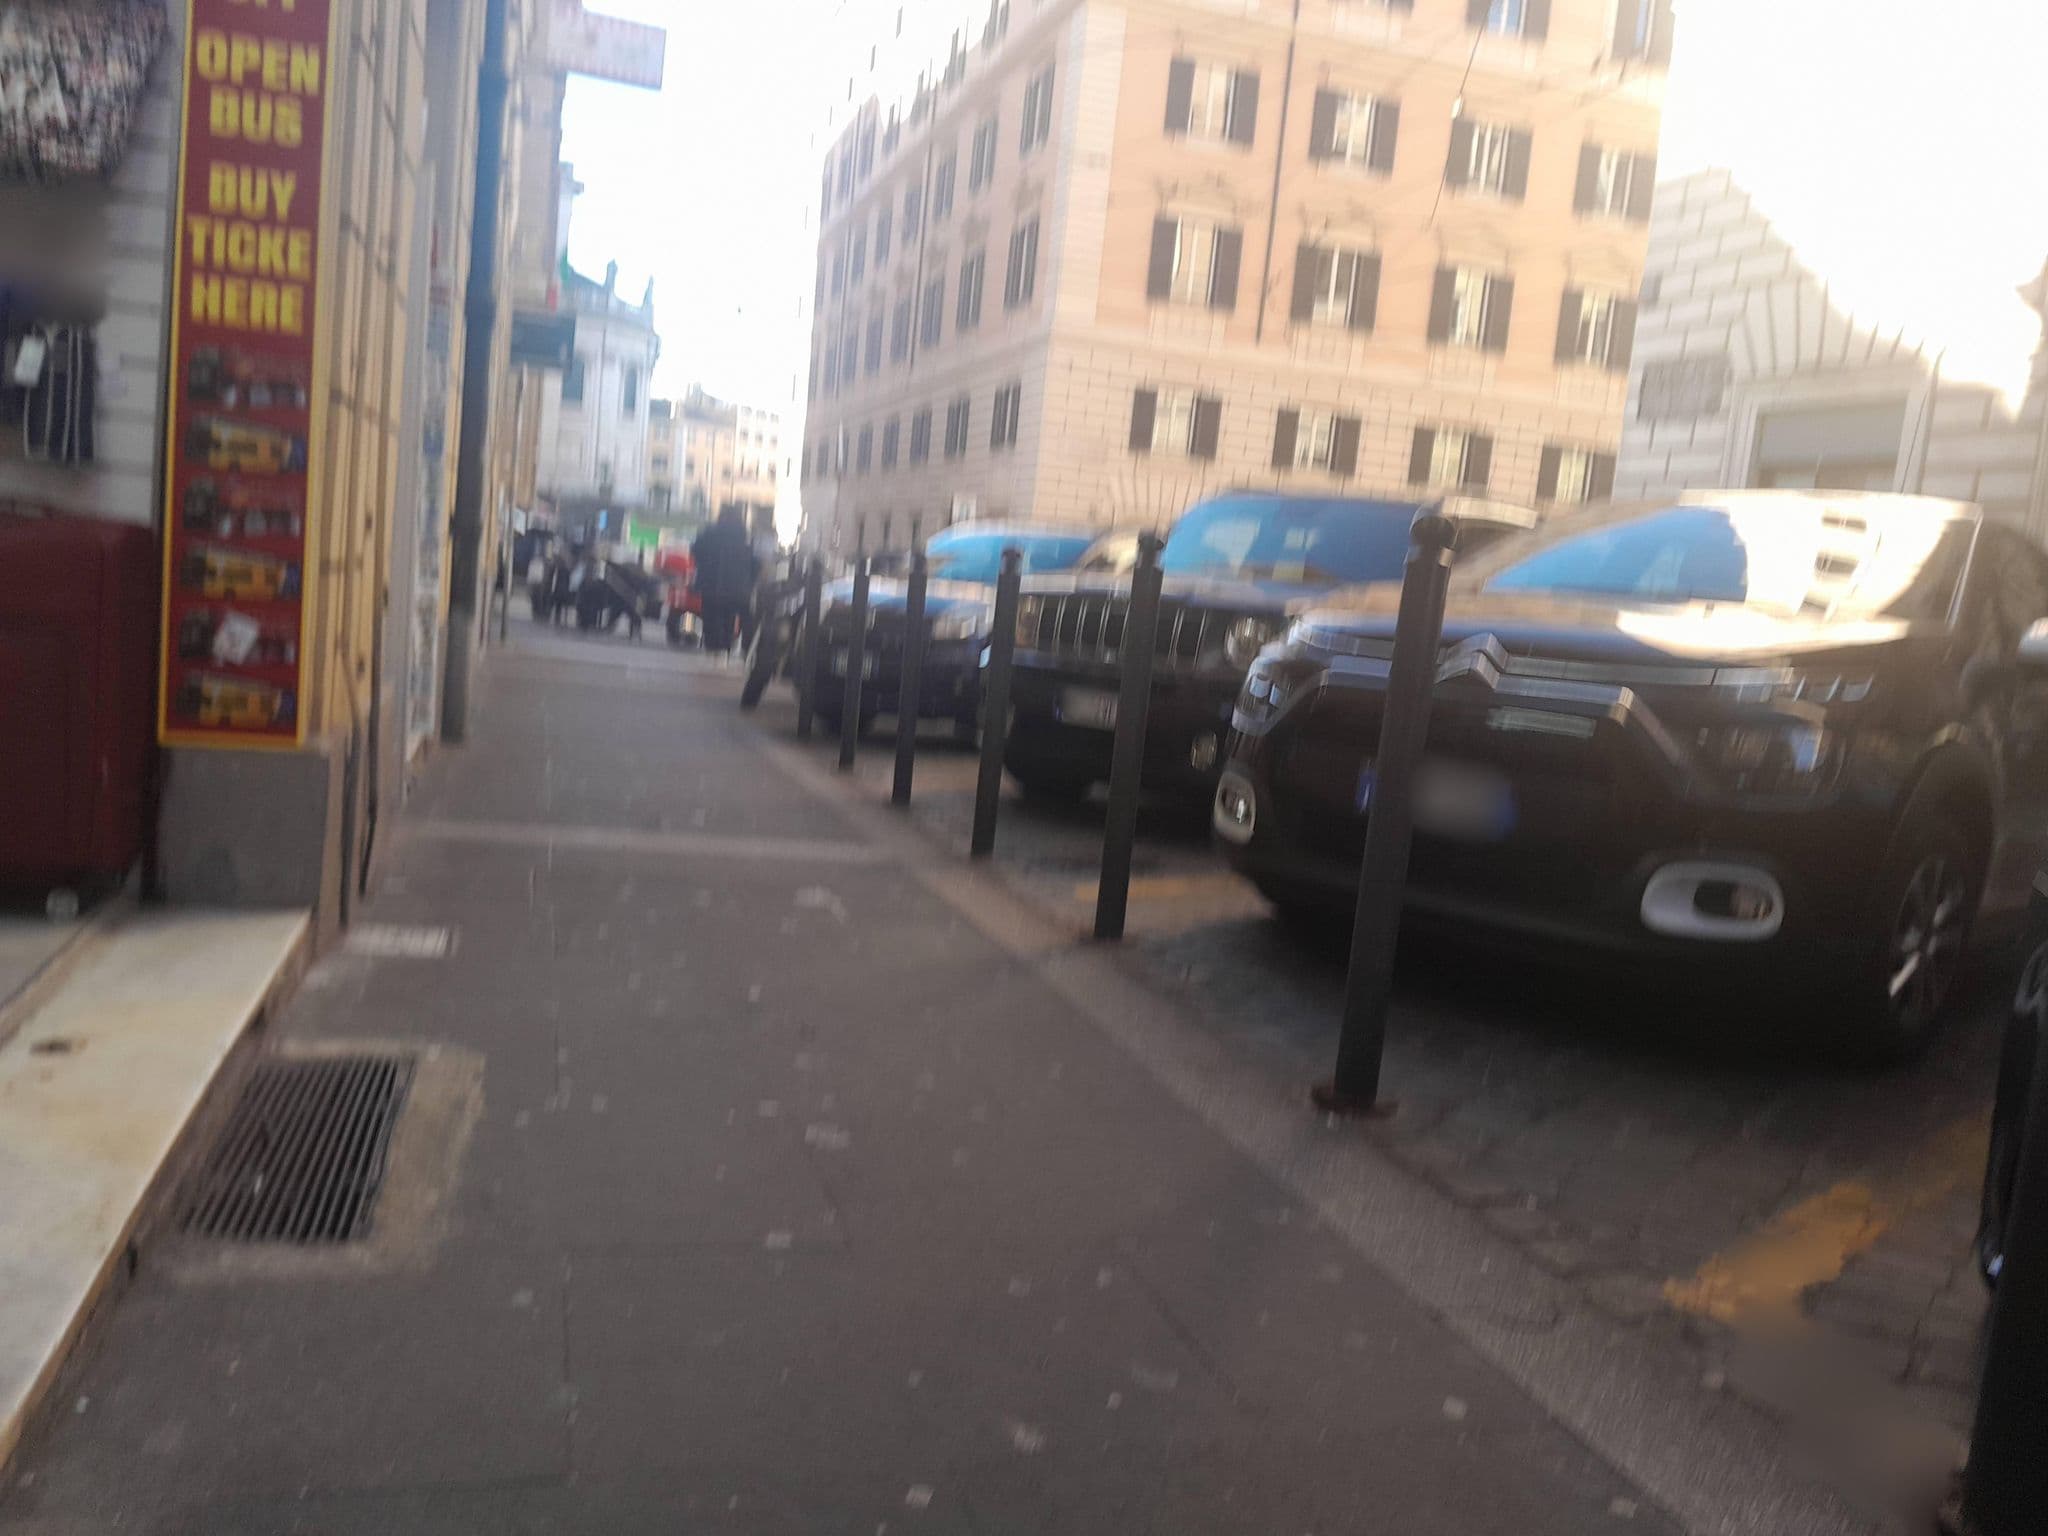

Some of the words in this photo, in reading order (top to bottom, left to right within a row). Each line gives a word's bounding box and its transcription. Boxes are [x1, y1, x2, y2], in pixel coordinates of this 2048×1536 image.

[196, 29, 319, 95] OPEN
[210, 87, 302, 147] BUS
[209, 161, 296, 221] BUY
[191, 273, 303, 334] HERE
